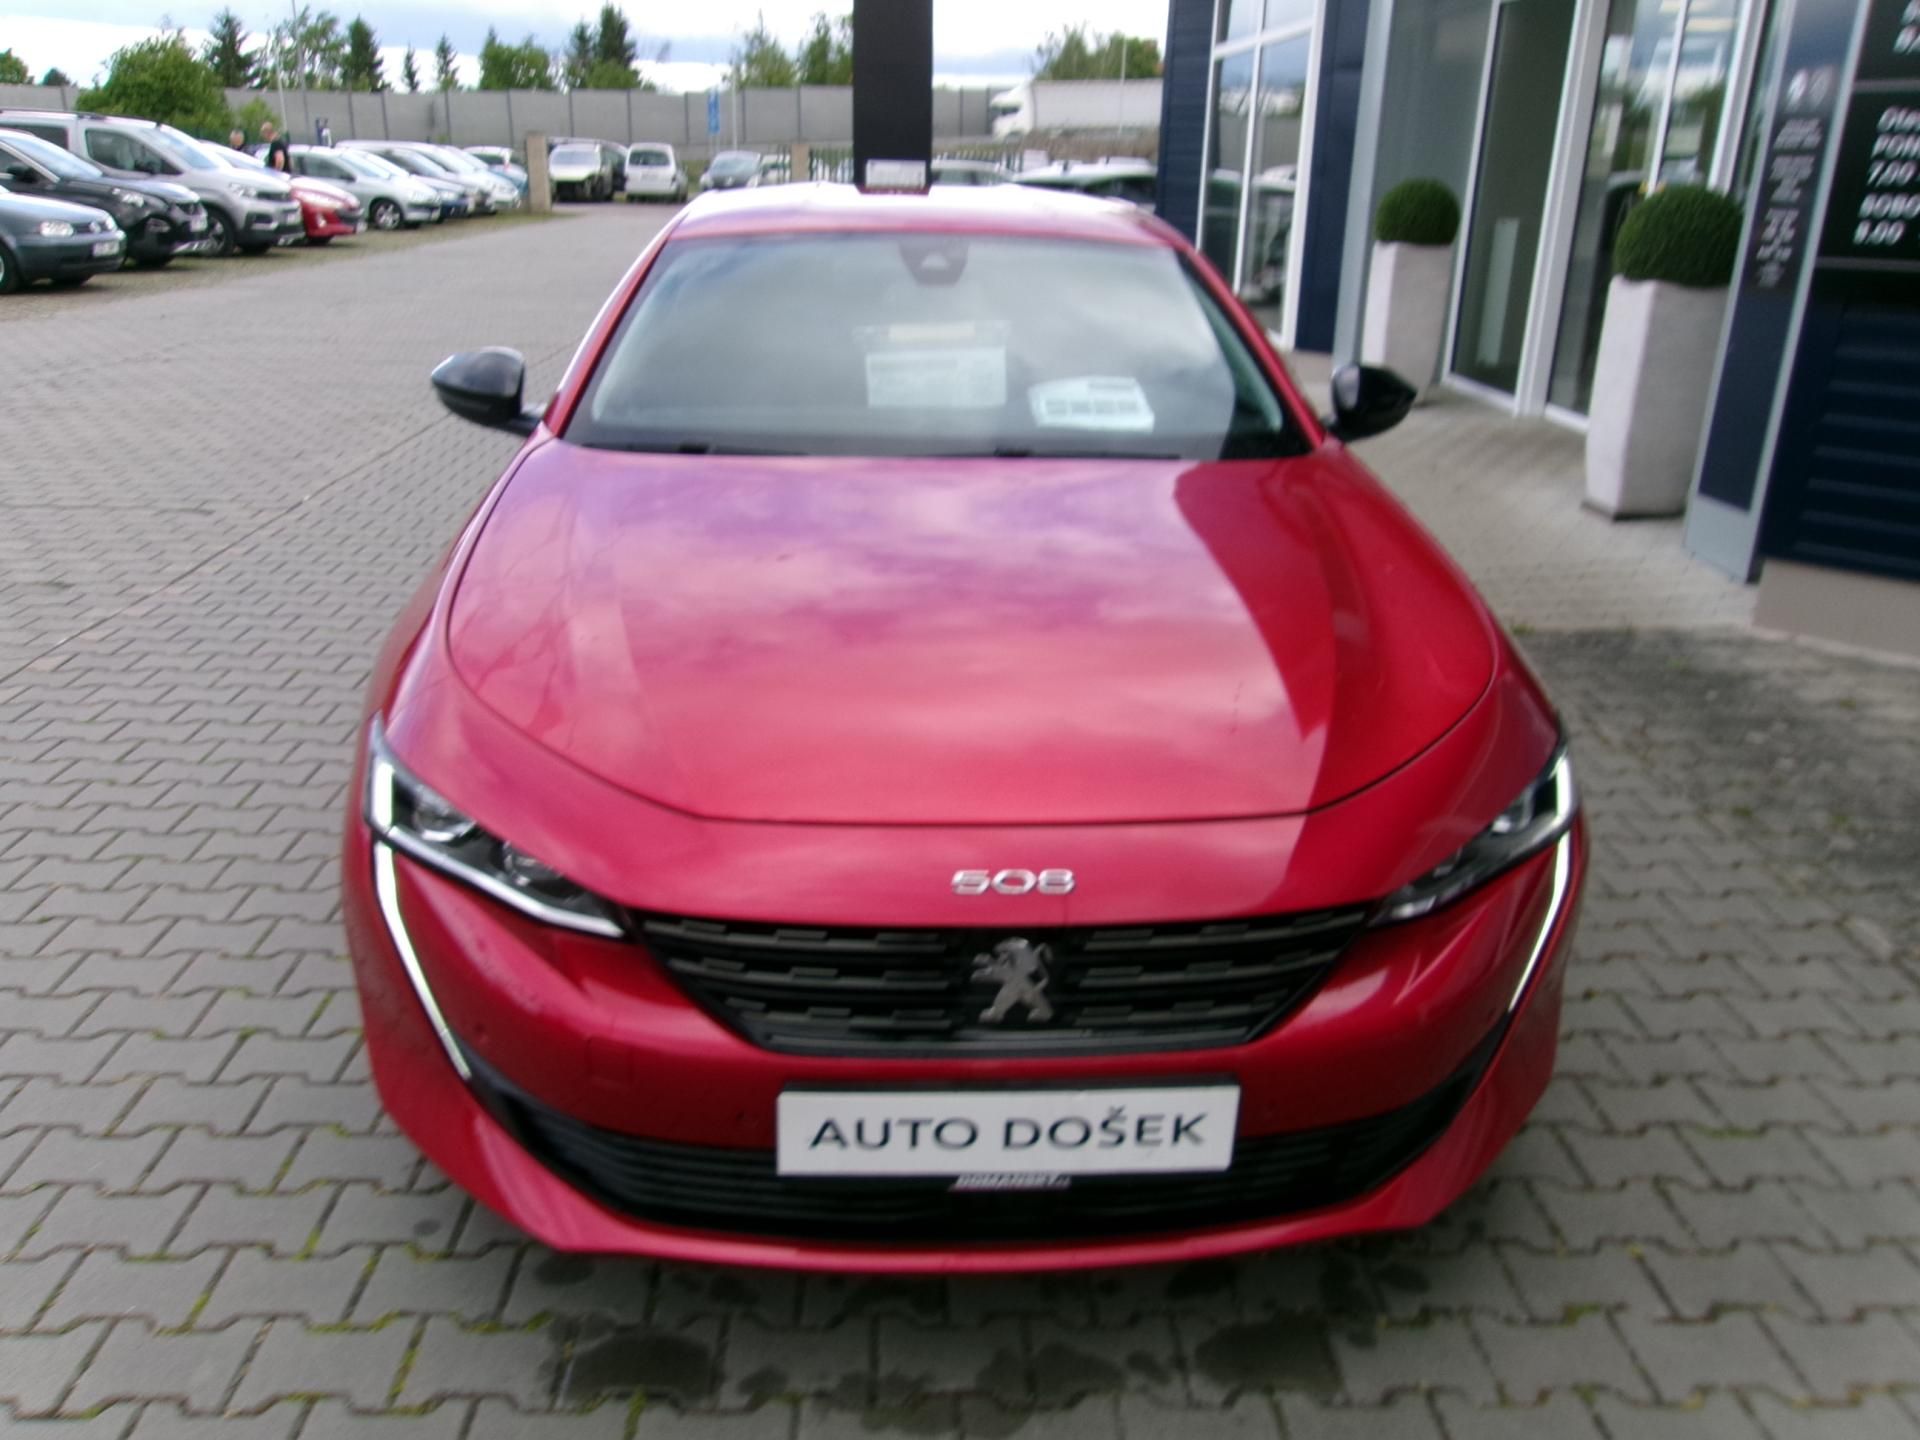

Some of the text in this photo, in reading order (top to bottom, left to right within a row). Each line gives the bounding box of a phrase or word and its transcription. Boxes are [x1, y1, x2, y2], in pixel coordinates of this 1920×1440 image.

[951, 868, 1076, 896] 508
[809, 1105, 1210, 1150] AUTO DOŠEK
